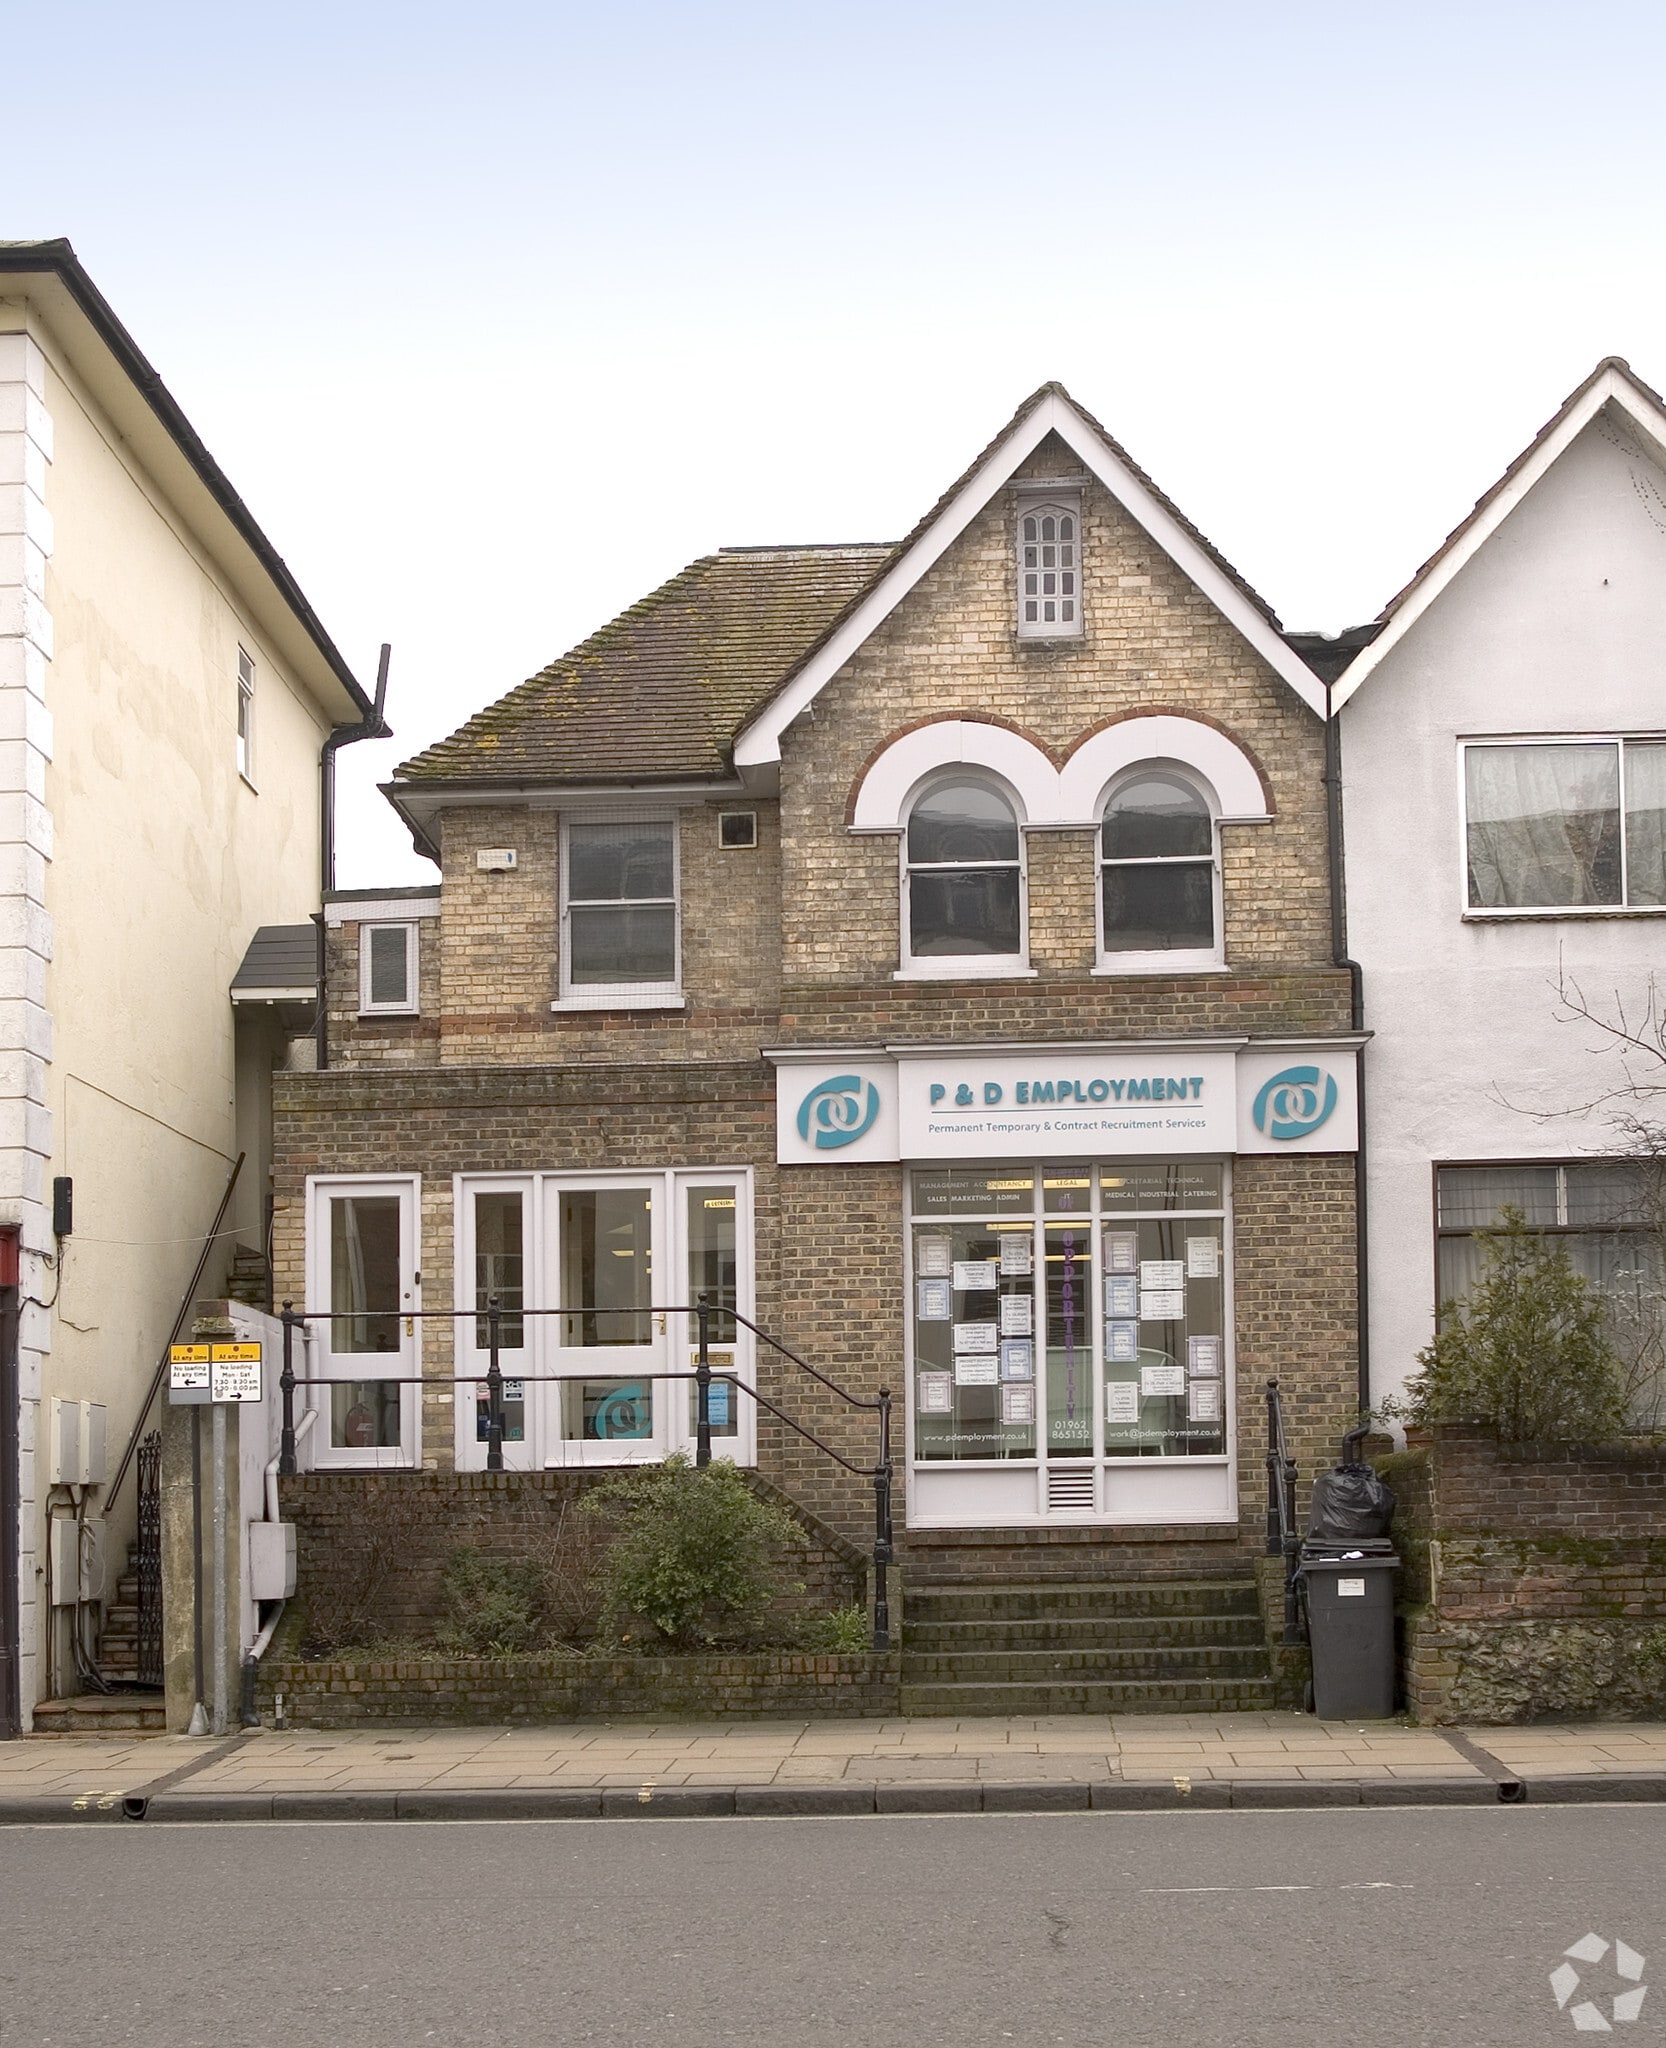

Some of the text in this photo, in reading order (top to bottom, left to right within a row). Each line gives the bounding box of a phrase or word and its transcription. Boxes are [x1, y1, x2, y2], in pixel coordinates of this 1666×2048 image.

[930, 1077, 1204, 1105] P & D EMPLOYMENT
[928, 1118, 1207, 1133] Permanent Temporary & Contract Recruitment Services
[926, 1195, 948, 1203] SALES
[950, 1194, 992, 1202] MARKETING
[1104, 1189, 1218, 1199] MEDICAL INDUSTRIAL CATERING
[1054, 1420, 1087, 1430] 01962
[923, 1432, 1027, 1442] www.pdemployment.co.uk
[1051, 1430, 1090, 1440] 865152
[1109, 1428, 1221, 1439] work@pdemployment.co.uk
